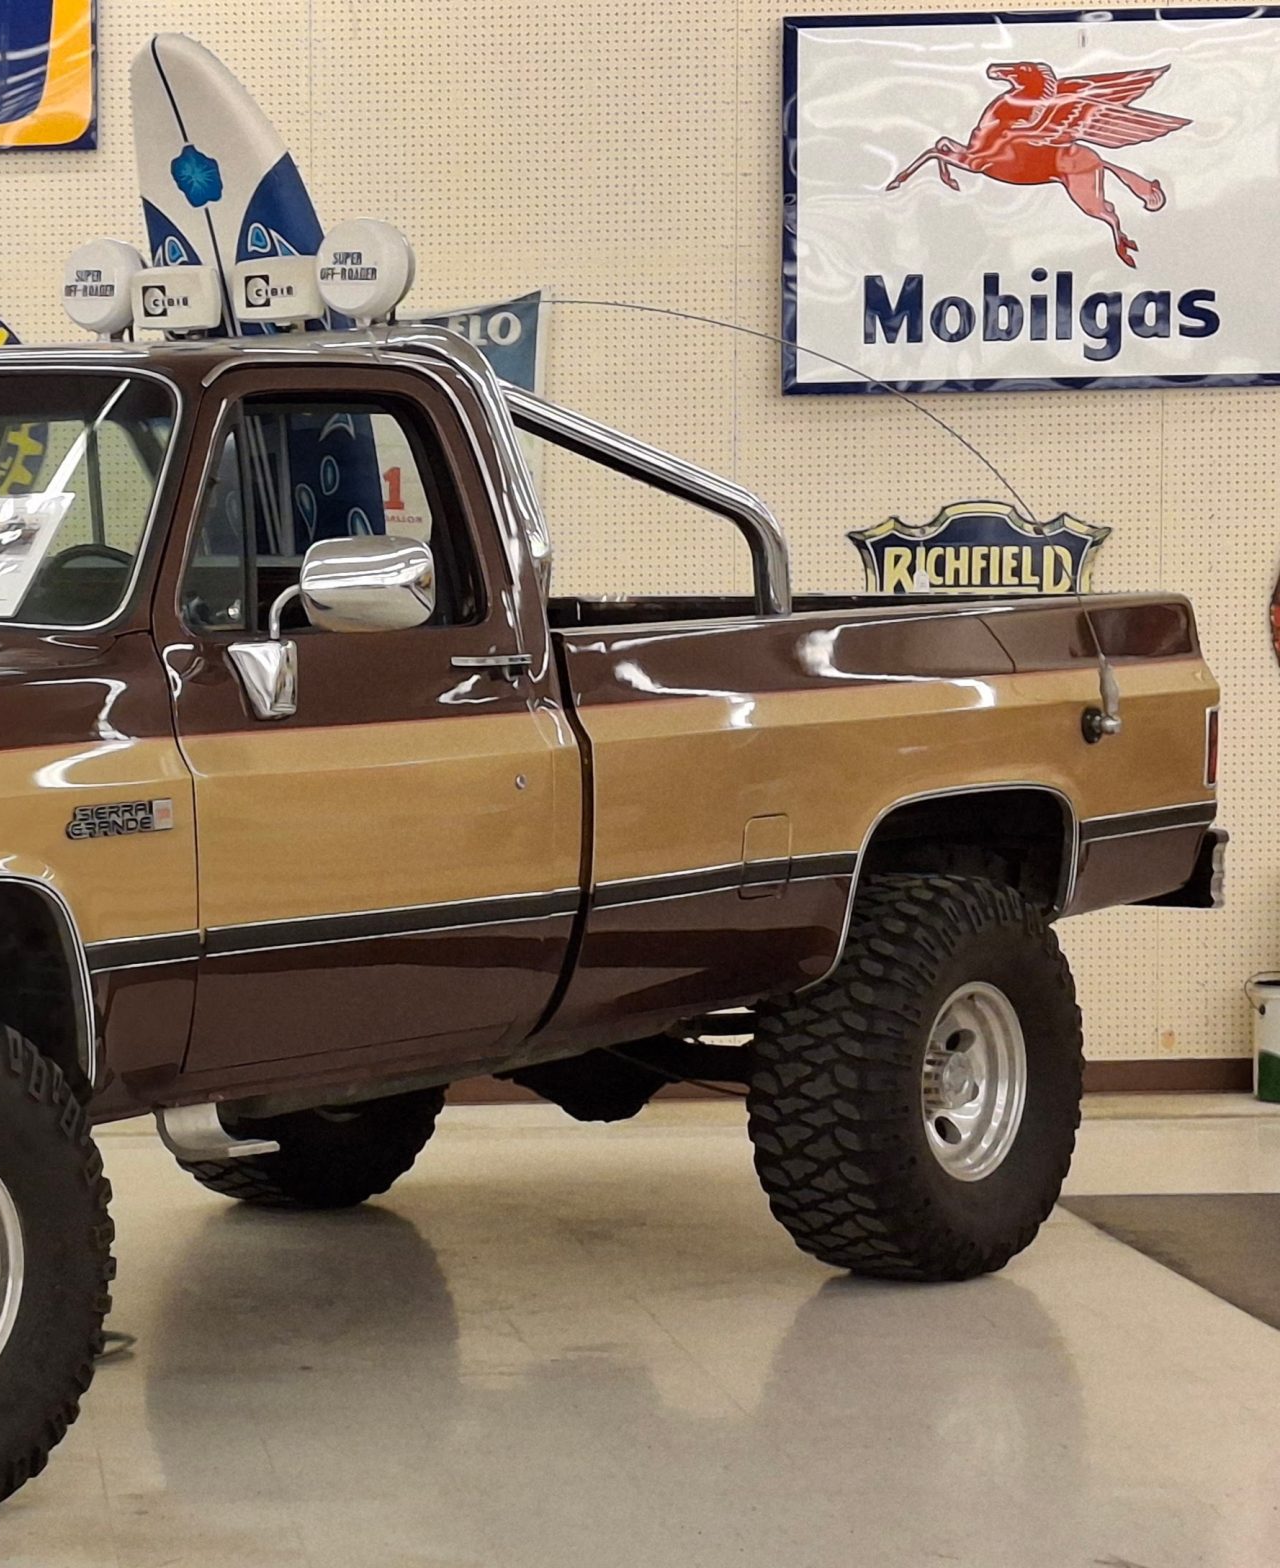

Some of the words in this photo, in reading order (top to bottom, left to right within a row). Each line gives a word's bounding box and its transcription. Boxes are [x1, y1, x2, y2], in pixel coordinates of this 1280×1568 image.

[333, 252, 362, 265] SUPER
[75, 270, 102, 282] SUPER
[320, 267, 377, 281] OFF-ROADER
[64, 285, 115, 297] OFF-ROADER
[864, 267, 1220, 361] Mobilgas
[384, 467, 405, 510] 1
[883, 545, 1073, 593] RICHFIELD
[75, 802, 149, 822] SIERRA
[70, 815, 153, 837] GRANDE
